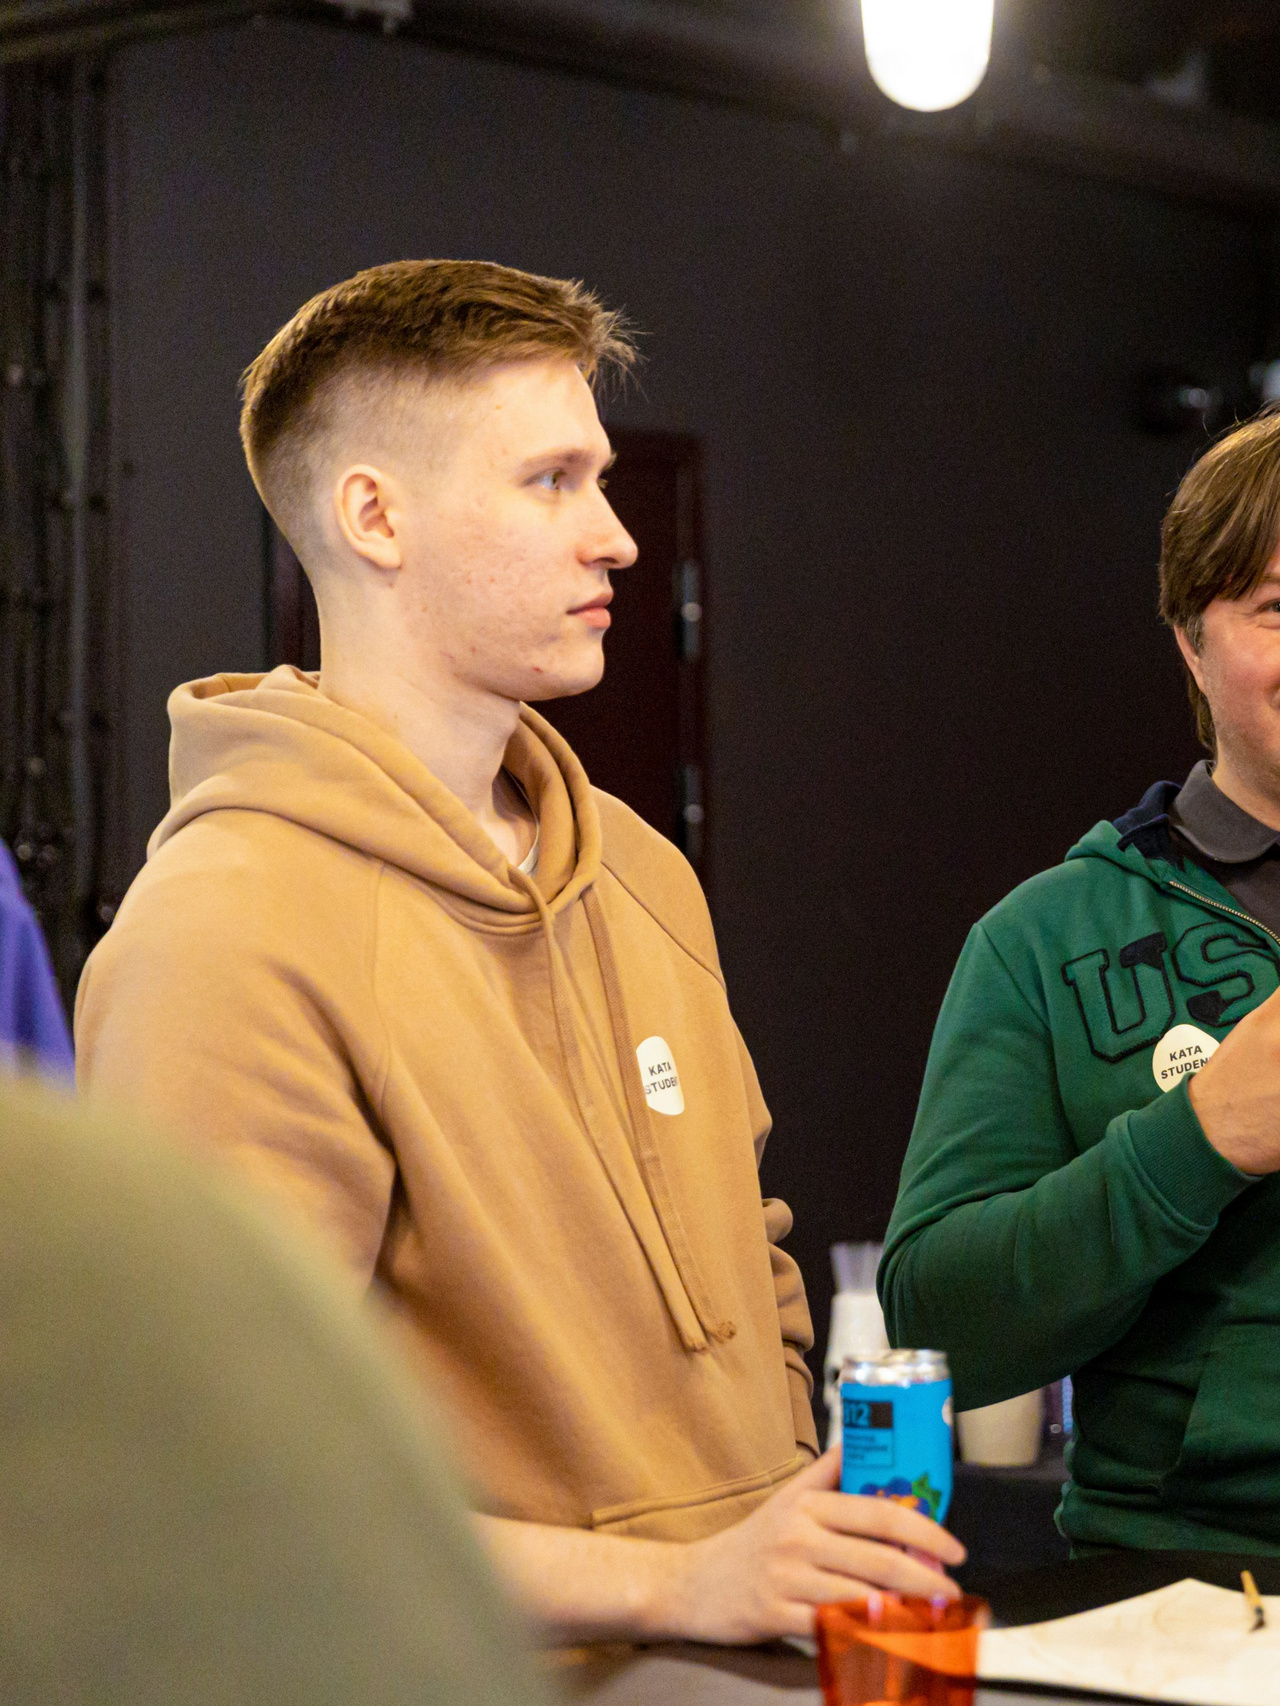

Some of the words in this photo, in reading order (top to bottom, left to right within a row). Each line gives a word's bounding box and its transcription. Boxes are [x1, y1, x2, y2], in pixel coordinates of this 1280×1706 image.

[1169, 1045, 1203, 1062] KATA
[648, 1061, 673, 1077] KATA
[1161, 1057, 1212, 1080] STUDEN
